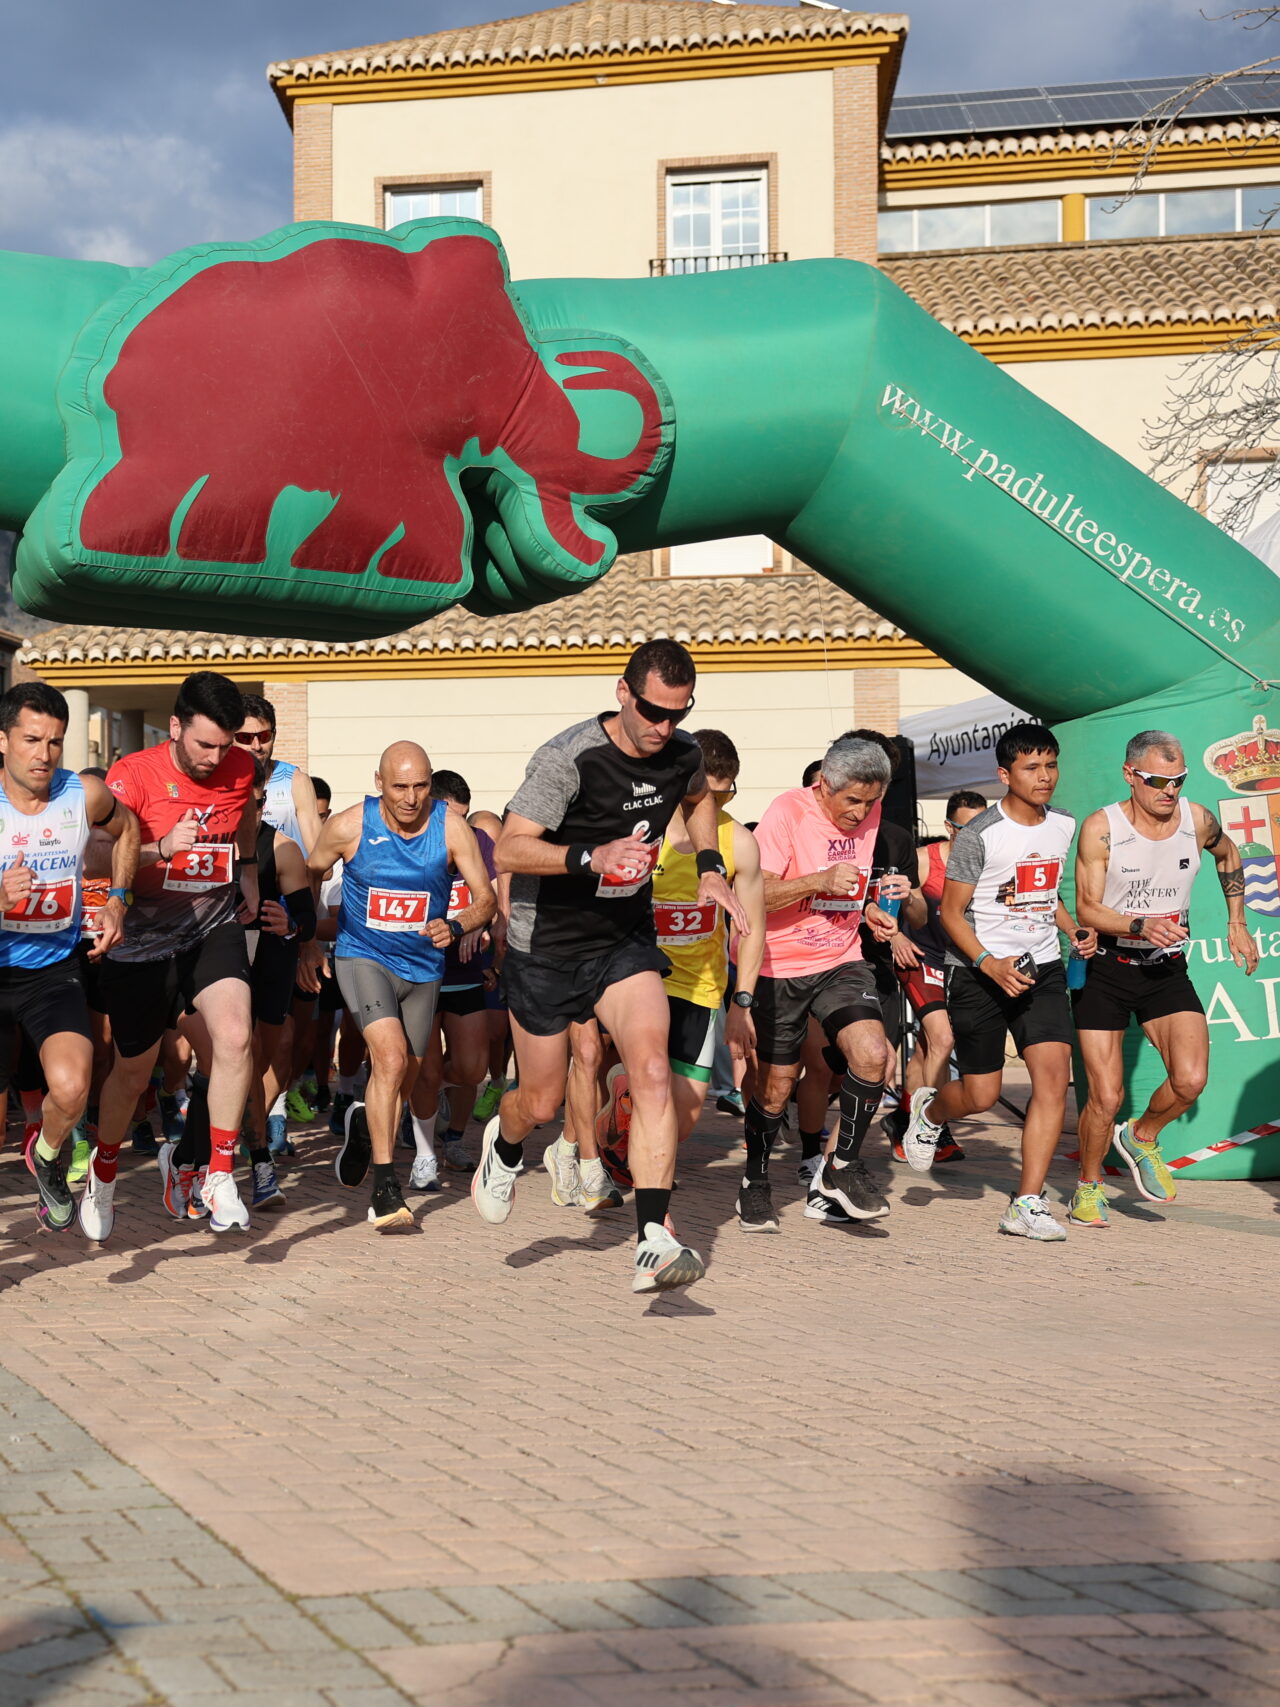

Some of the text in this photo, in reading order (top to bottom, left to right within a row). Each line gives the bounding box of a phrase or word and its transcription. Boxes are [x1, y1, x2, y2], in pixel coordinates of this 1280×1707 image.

[880, 383, 1246, 642] www.padulteespera.es
[623, 795, 663, 811] CLAC CLAC
[828, 838, 856, 851] XVII
[184, 853, 214, 876] 33
[1033, 867, 1047, 887] 5
[1128, 878, 1152, 890] THE
[1126, 887, 1180, 899] MYSTERY
[24, 891, 59, 916] 76
[378, 898, 419, 918] 147
[1124, 899, 1152, 909] MAN
[669, 911, 703, 931] 32
